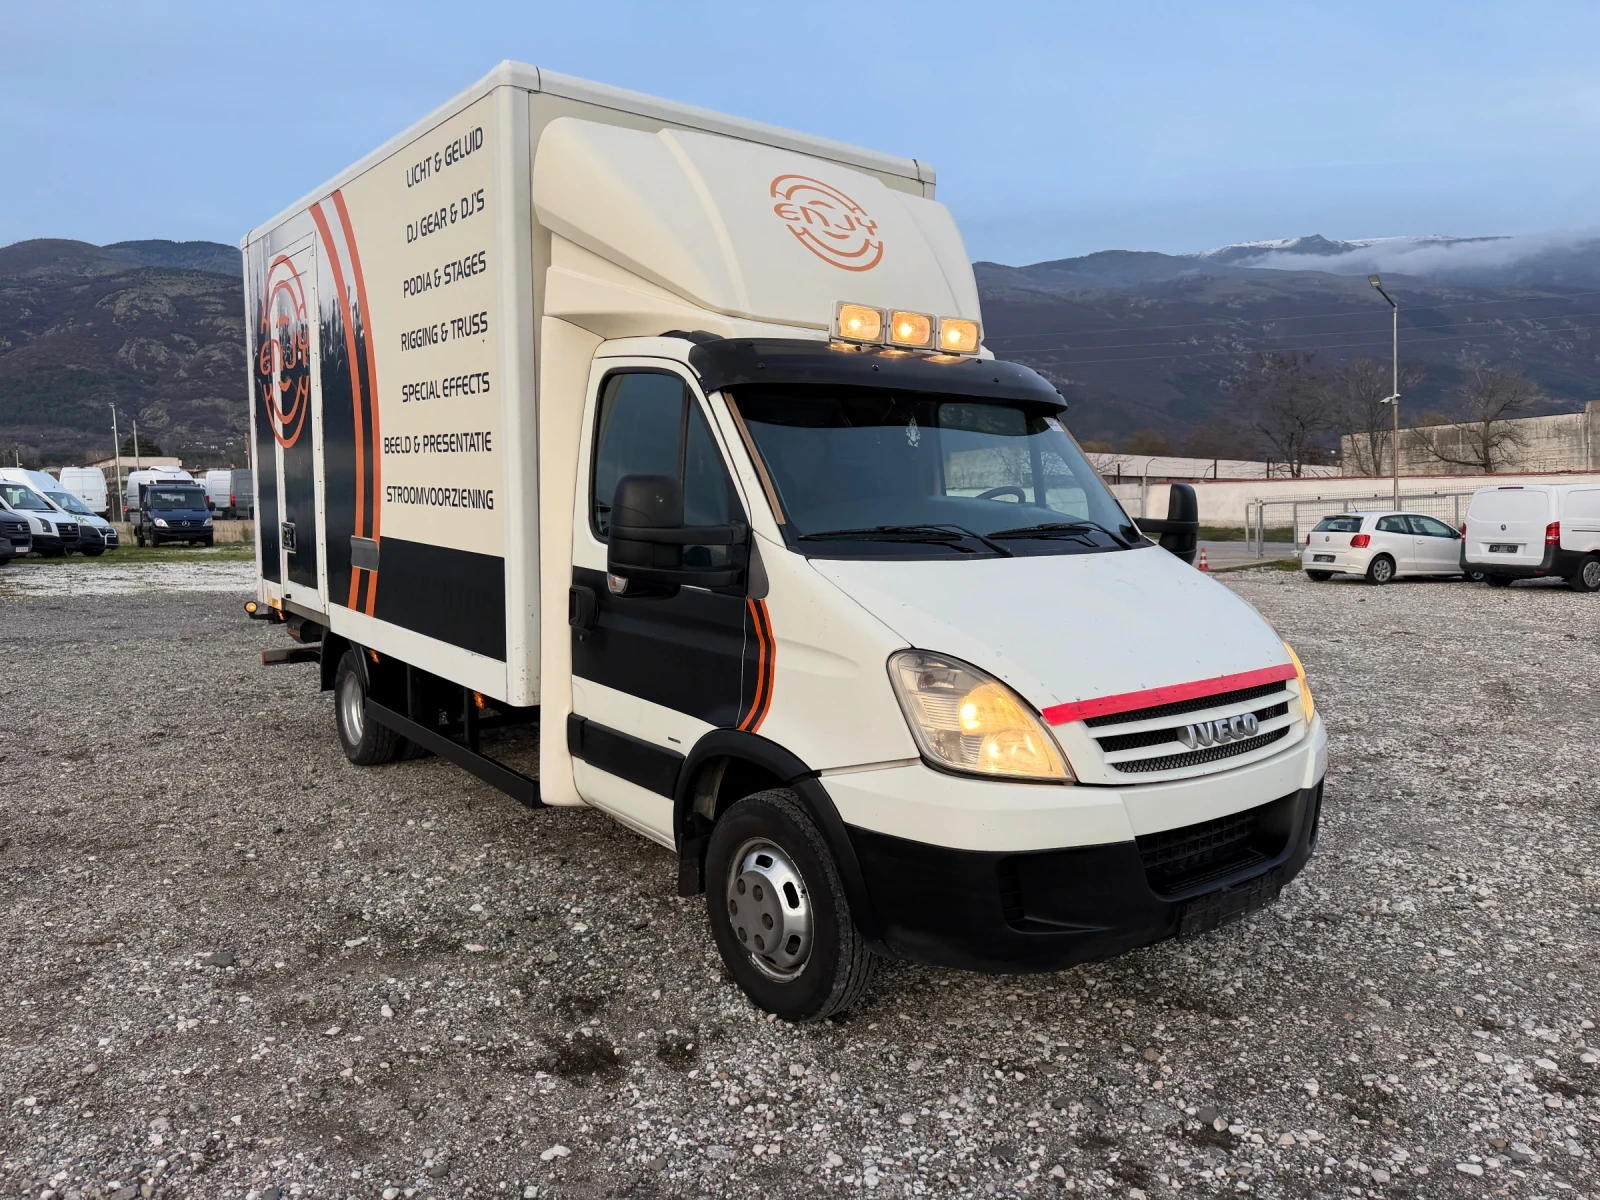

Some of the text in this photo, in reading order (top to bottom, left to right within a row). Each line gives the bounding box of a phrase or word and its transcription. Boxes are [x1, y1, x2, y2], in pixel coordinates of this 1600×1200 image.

[406, 126, 484, 188] LICHT & GELUID
[406, 188, 485, 243] DJ GEAR & DJ'S
[403, 250, 487, 298] PODIA & STAGES
[401, 311, 488, 352] RIGGING & TRUSS
[402, 372, 490, 403] SPECIAL EFFECTS
[384, 431, 492, 454] BEELD & PRESENTATIE
[386, 485, 494, 510] STROOMVOORZIENING
[1183, 712, 1260, 749] IVECO
